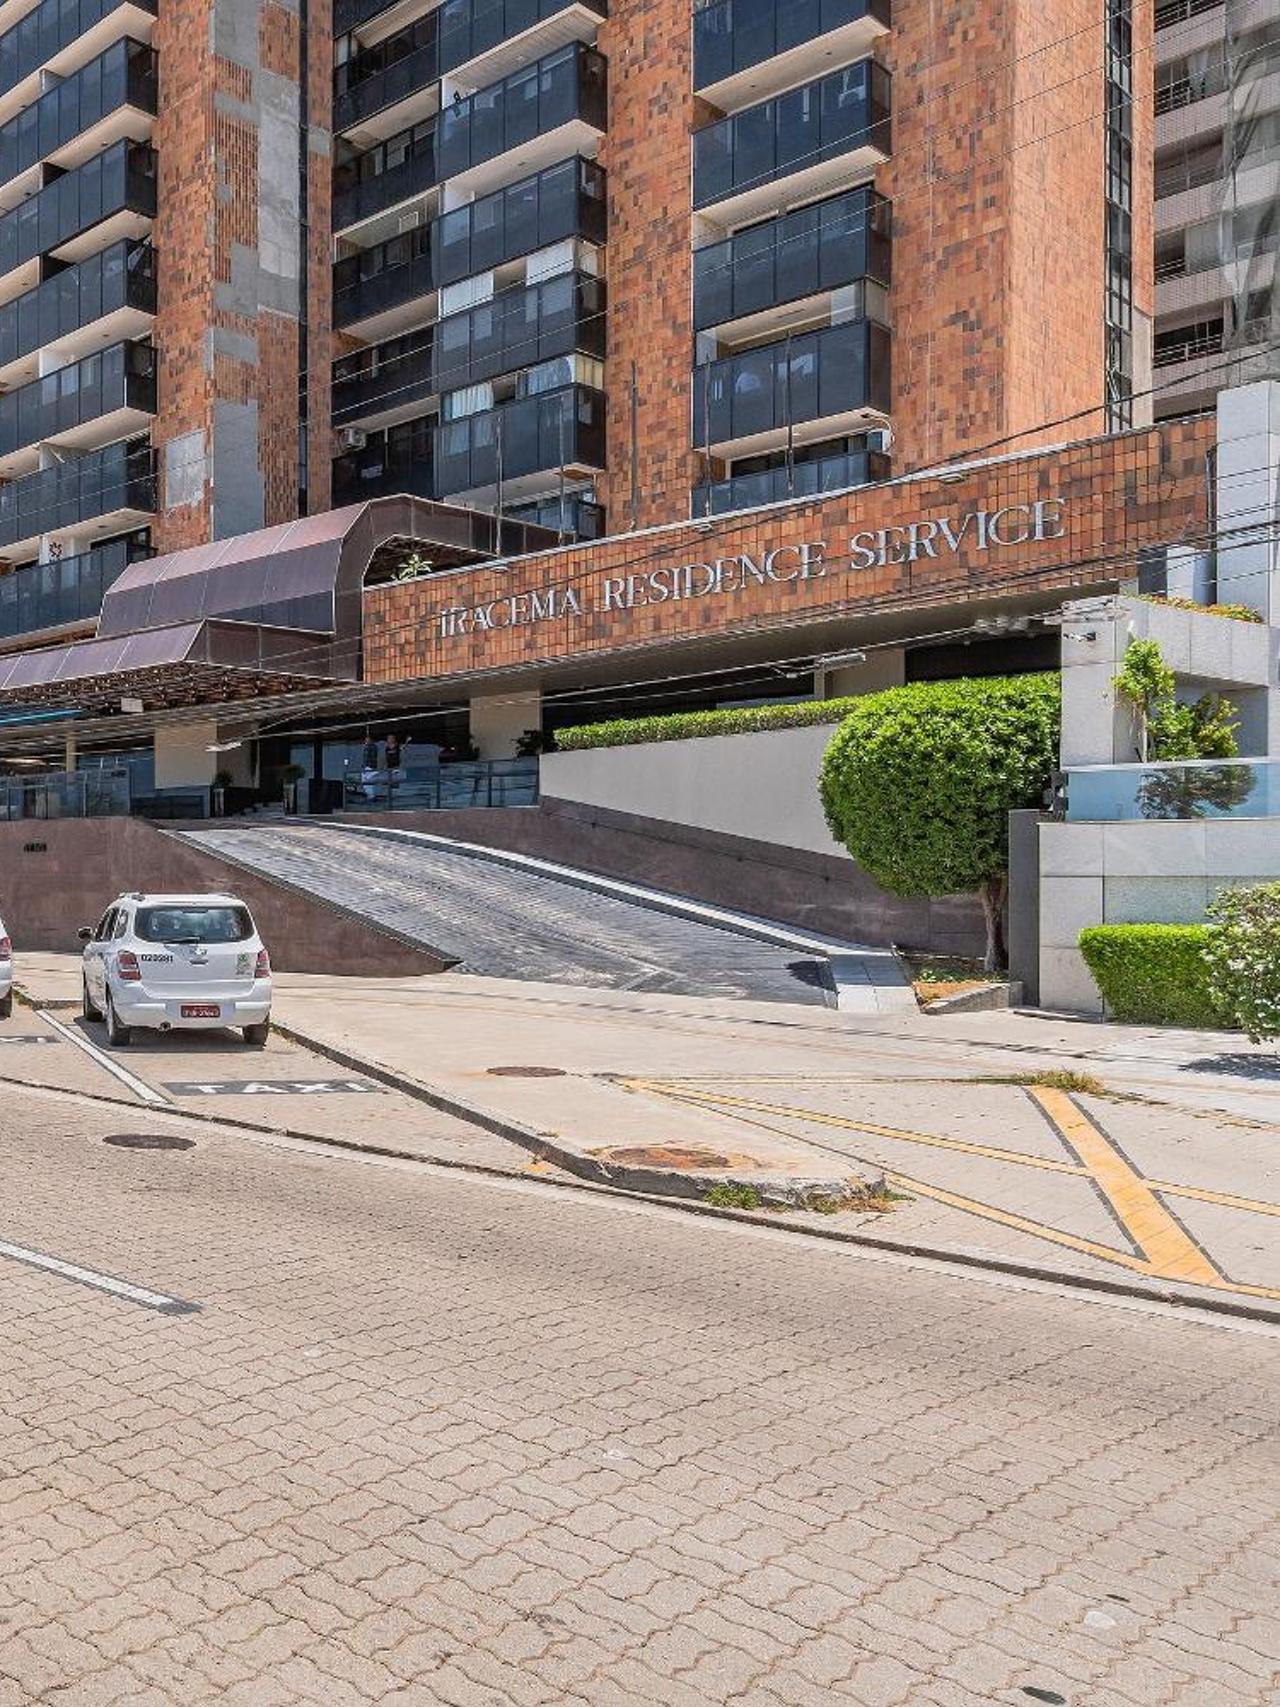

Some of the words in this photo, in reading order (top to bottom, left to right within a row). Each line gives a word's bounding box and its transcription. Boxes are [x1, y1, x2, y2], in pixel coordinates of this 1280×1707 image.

[439, 587, 583, 638] IRACEMA
[594, 542, 826, 612] RESIDENCE
[849, 498, 1065, 570] SERVICE
[184, 1082, 367, 1094] TAXI
